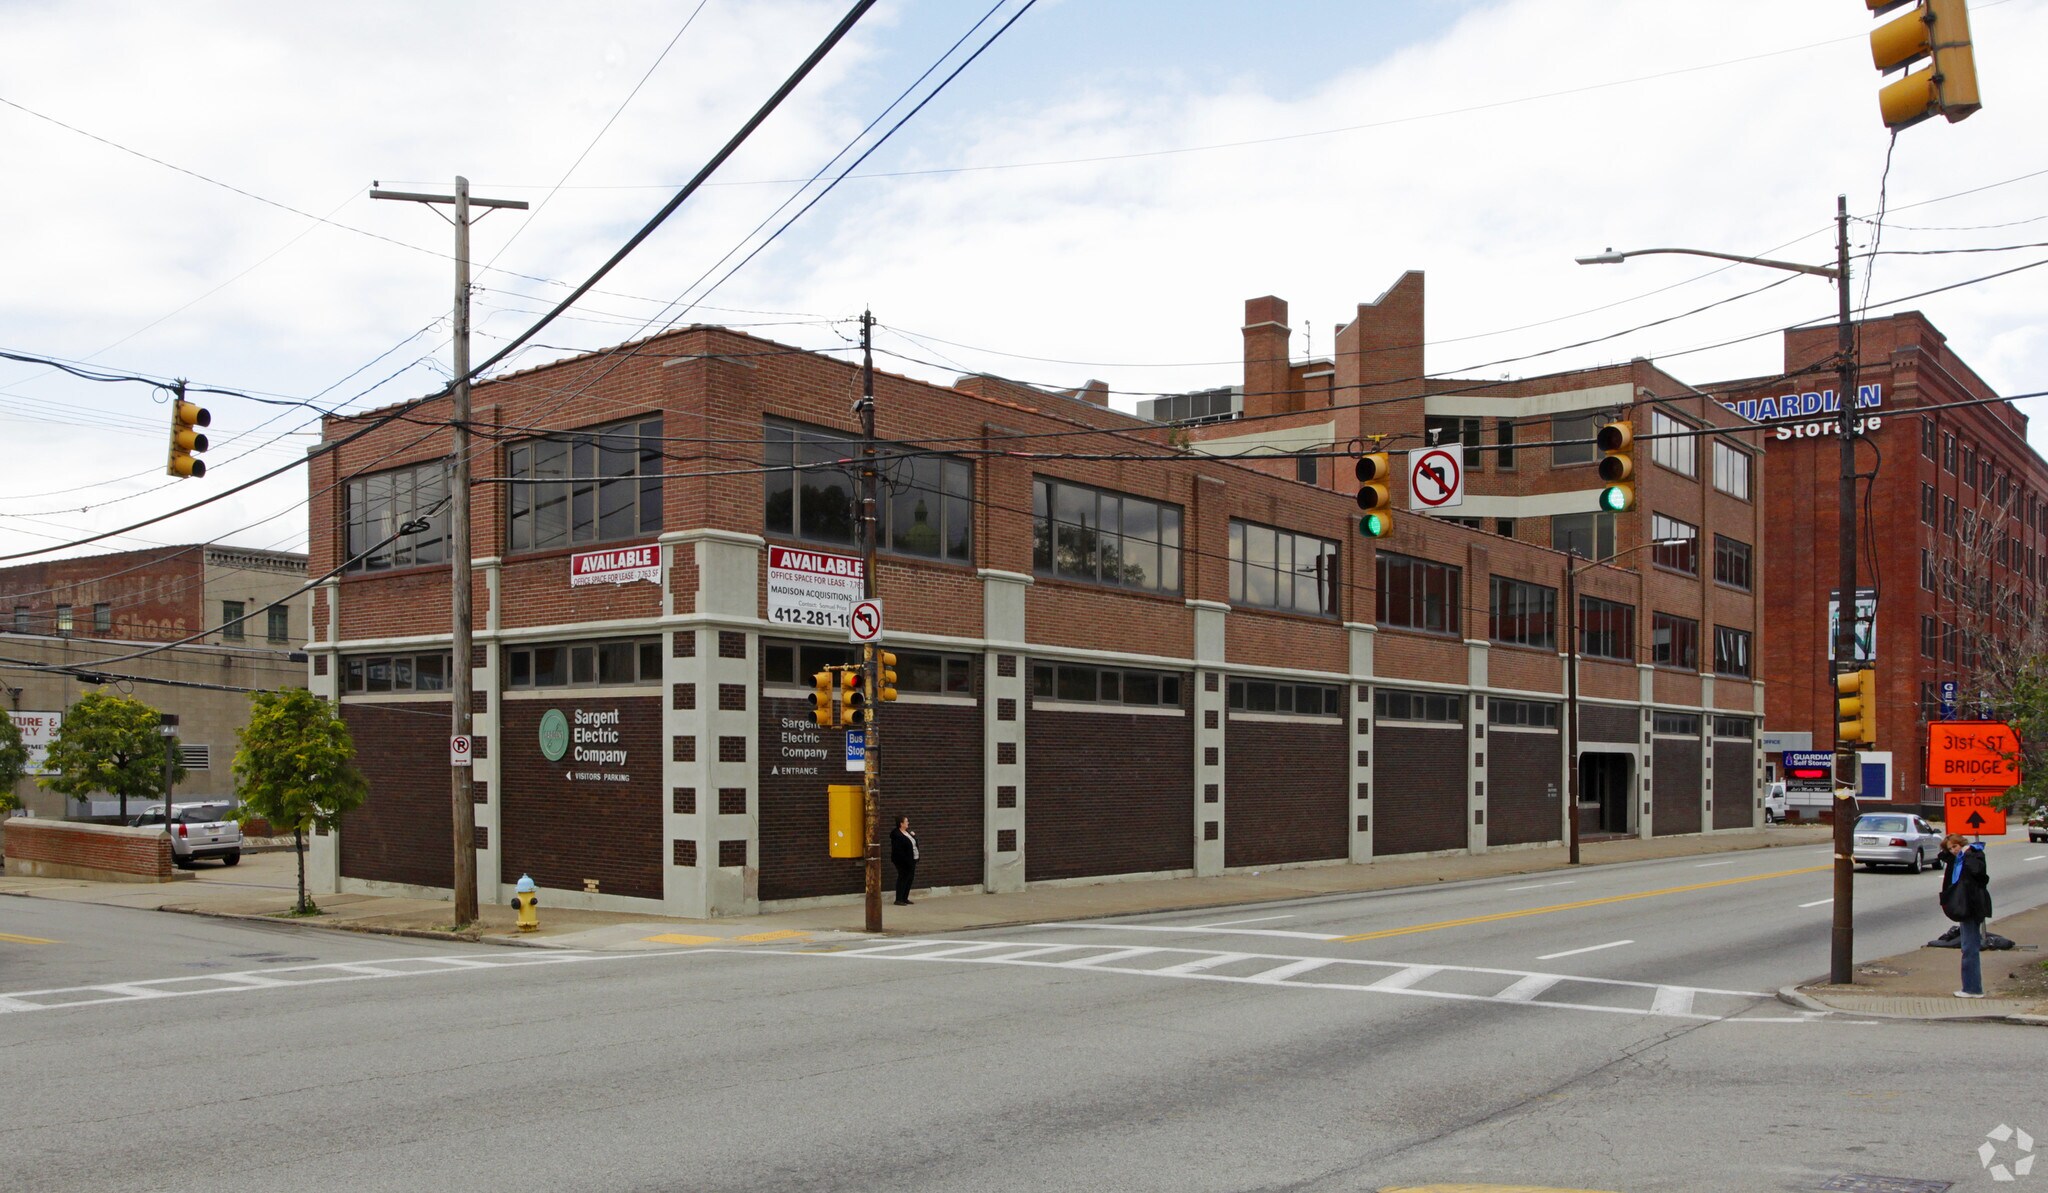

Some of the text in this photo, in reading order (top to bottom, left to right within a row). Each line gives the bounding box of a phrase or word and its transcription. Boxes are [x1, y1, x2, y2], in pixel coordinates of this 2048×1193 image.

[581, 549, 652, 573] AVAILABLE
[780, 551, 863, 577] AVAILABLE
[592, 575, 607, 584] SPACE
[607, 573, 619, 583] FOR
[619, 571, 634, 580] LEASE
[652, 568, 659, 577] SF
[770, 571, 793, 581] OFFICE
[794, 574, 812, 583] SPACE
[814, 576, 827, 585] FOR
[827, 578, 846, 588] LEASE
[771, 585, 805, 597] MADISON
[806, 588, 853, 602] ACQUISITIONS
[775, 607, 849, 628] 412-281-1
[116, 613, 188, 641] Shoes
[574, 708, 619, 728] Sargent
[574, 728, 619, 743] Electric
[781, 732, 820, 744] Electric
[849, 733, 863, 744] Bus
[1943, 735, 2004, 750] 31ST ST
[574, 746, 627, 765] Company
[781, 746, 828, 760] Company
[848, 745, 865, 757] Stop
[781, 767, 818, 775] ENTRANCE
[1944, 760, 2002, 774] BRIDGE
[575, 772, 630, 782] VISITORS PARKING
[1950, 796, 1991, 807] DETOU
